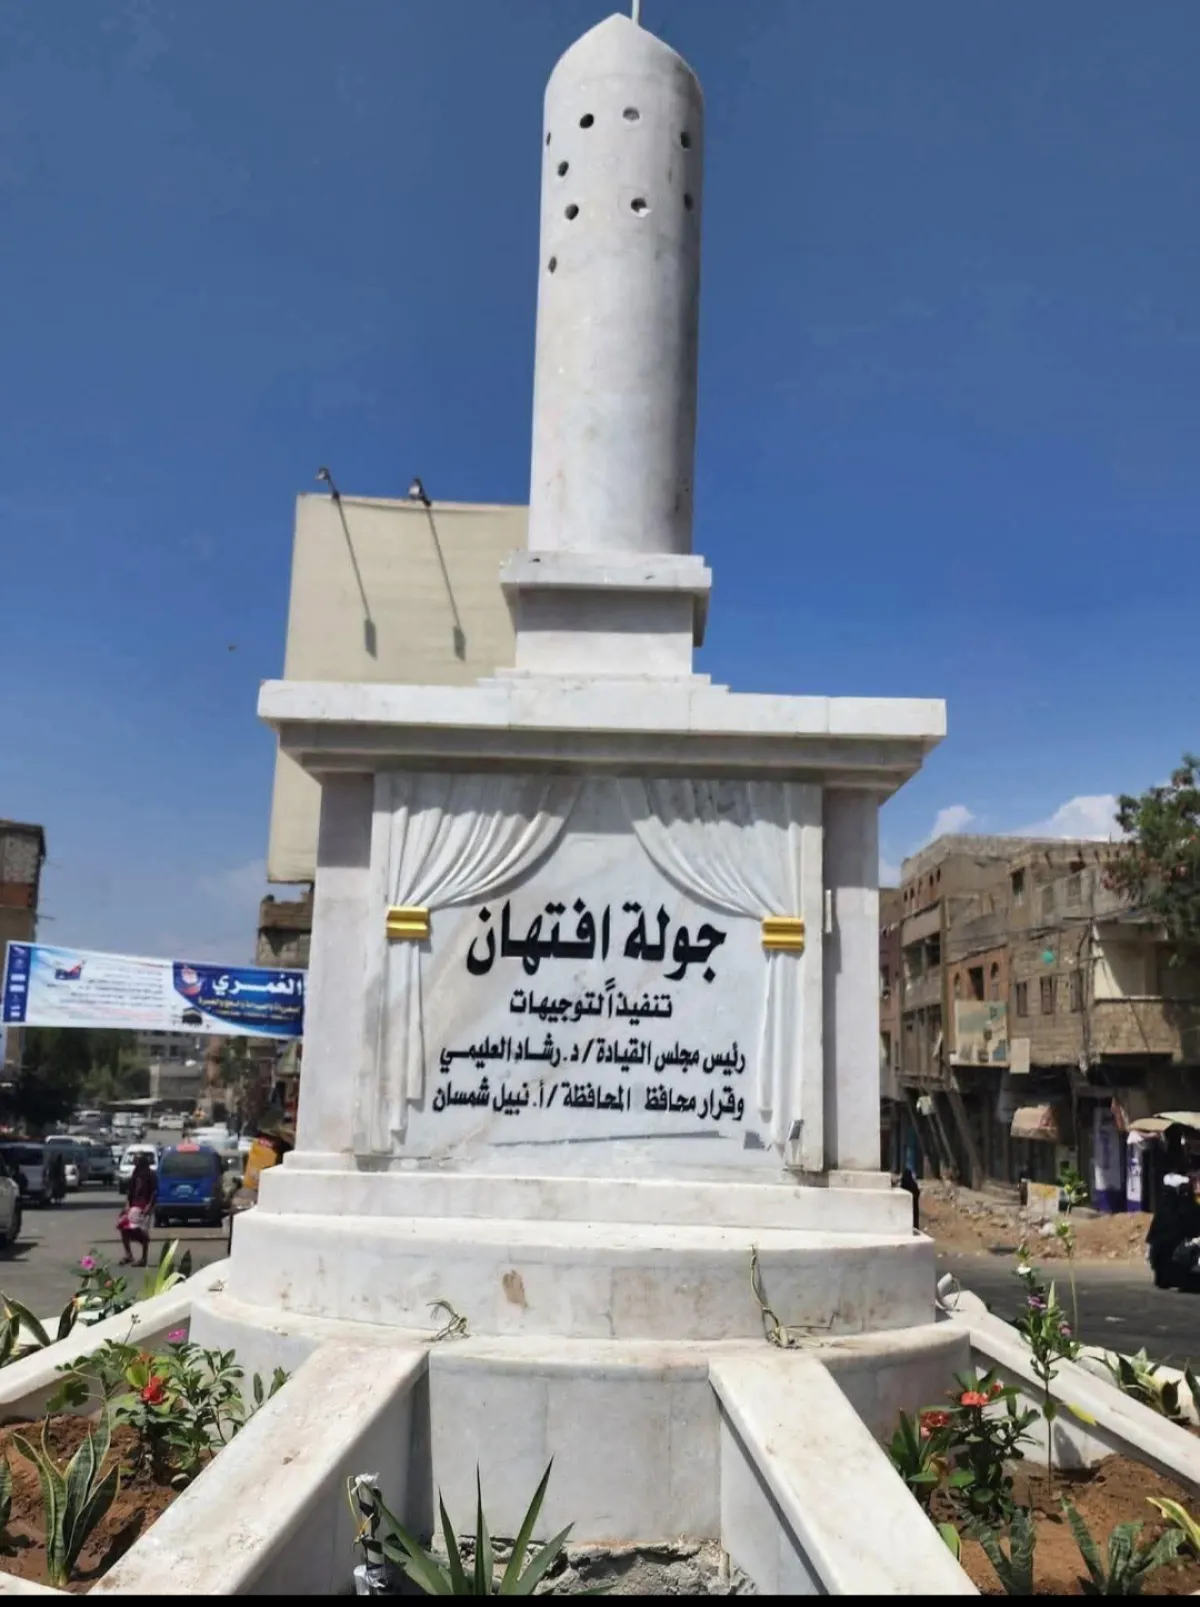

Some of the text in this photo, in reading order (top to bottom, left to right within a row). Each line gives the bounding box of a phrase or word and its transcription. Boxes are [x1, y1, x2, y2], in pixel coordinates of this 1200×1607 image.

[466, 897, 727, 984] جولة افتهان
[509, 977, 673, 1026] تنفيذاً لتوجيهات
[439, 1035, 512, 1074] العليمي
[654, 1040, 700, 1074] مجلس
[702, 1040, 746, 1076] رئيس
[432, 1076, 491, 1113] شمسان
[492, 1082, 530, 1116] نبيل
[644, 1083, 697, 1113] محافظ
[697, 1085, 745, 1122] وقرار
